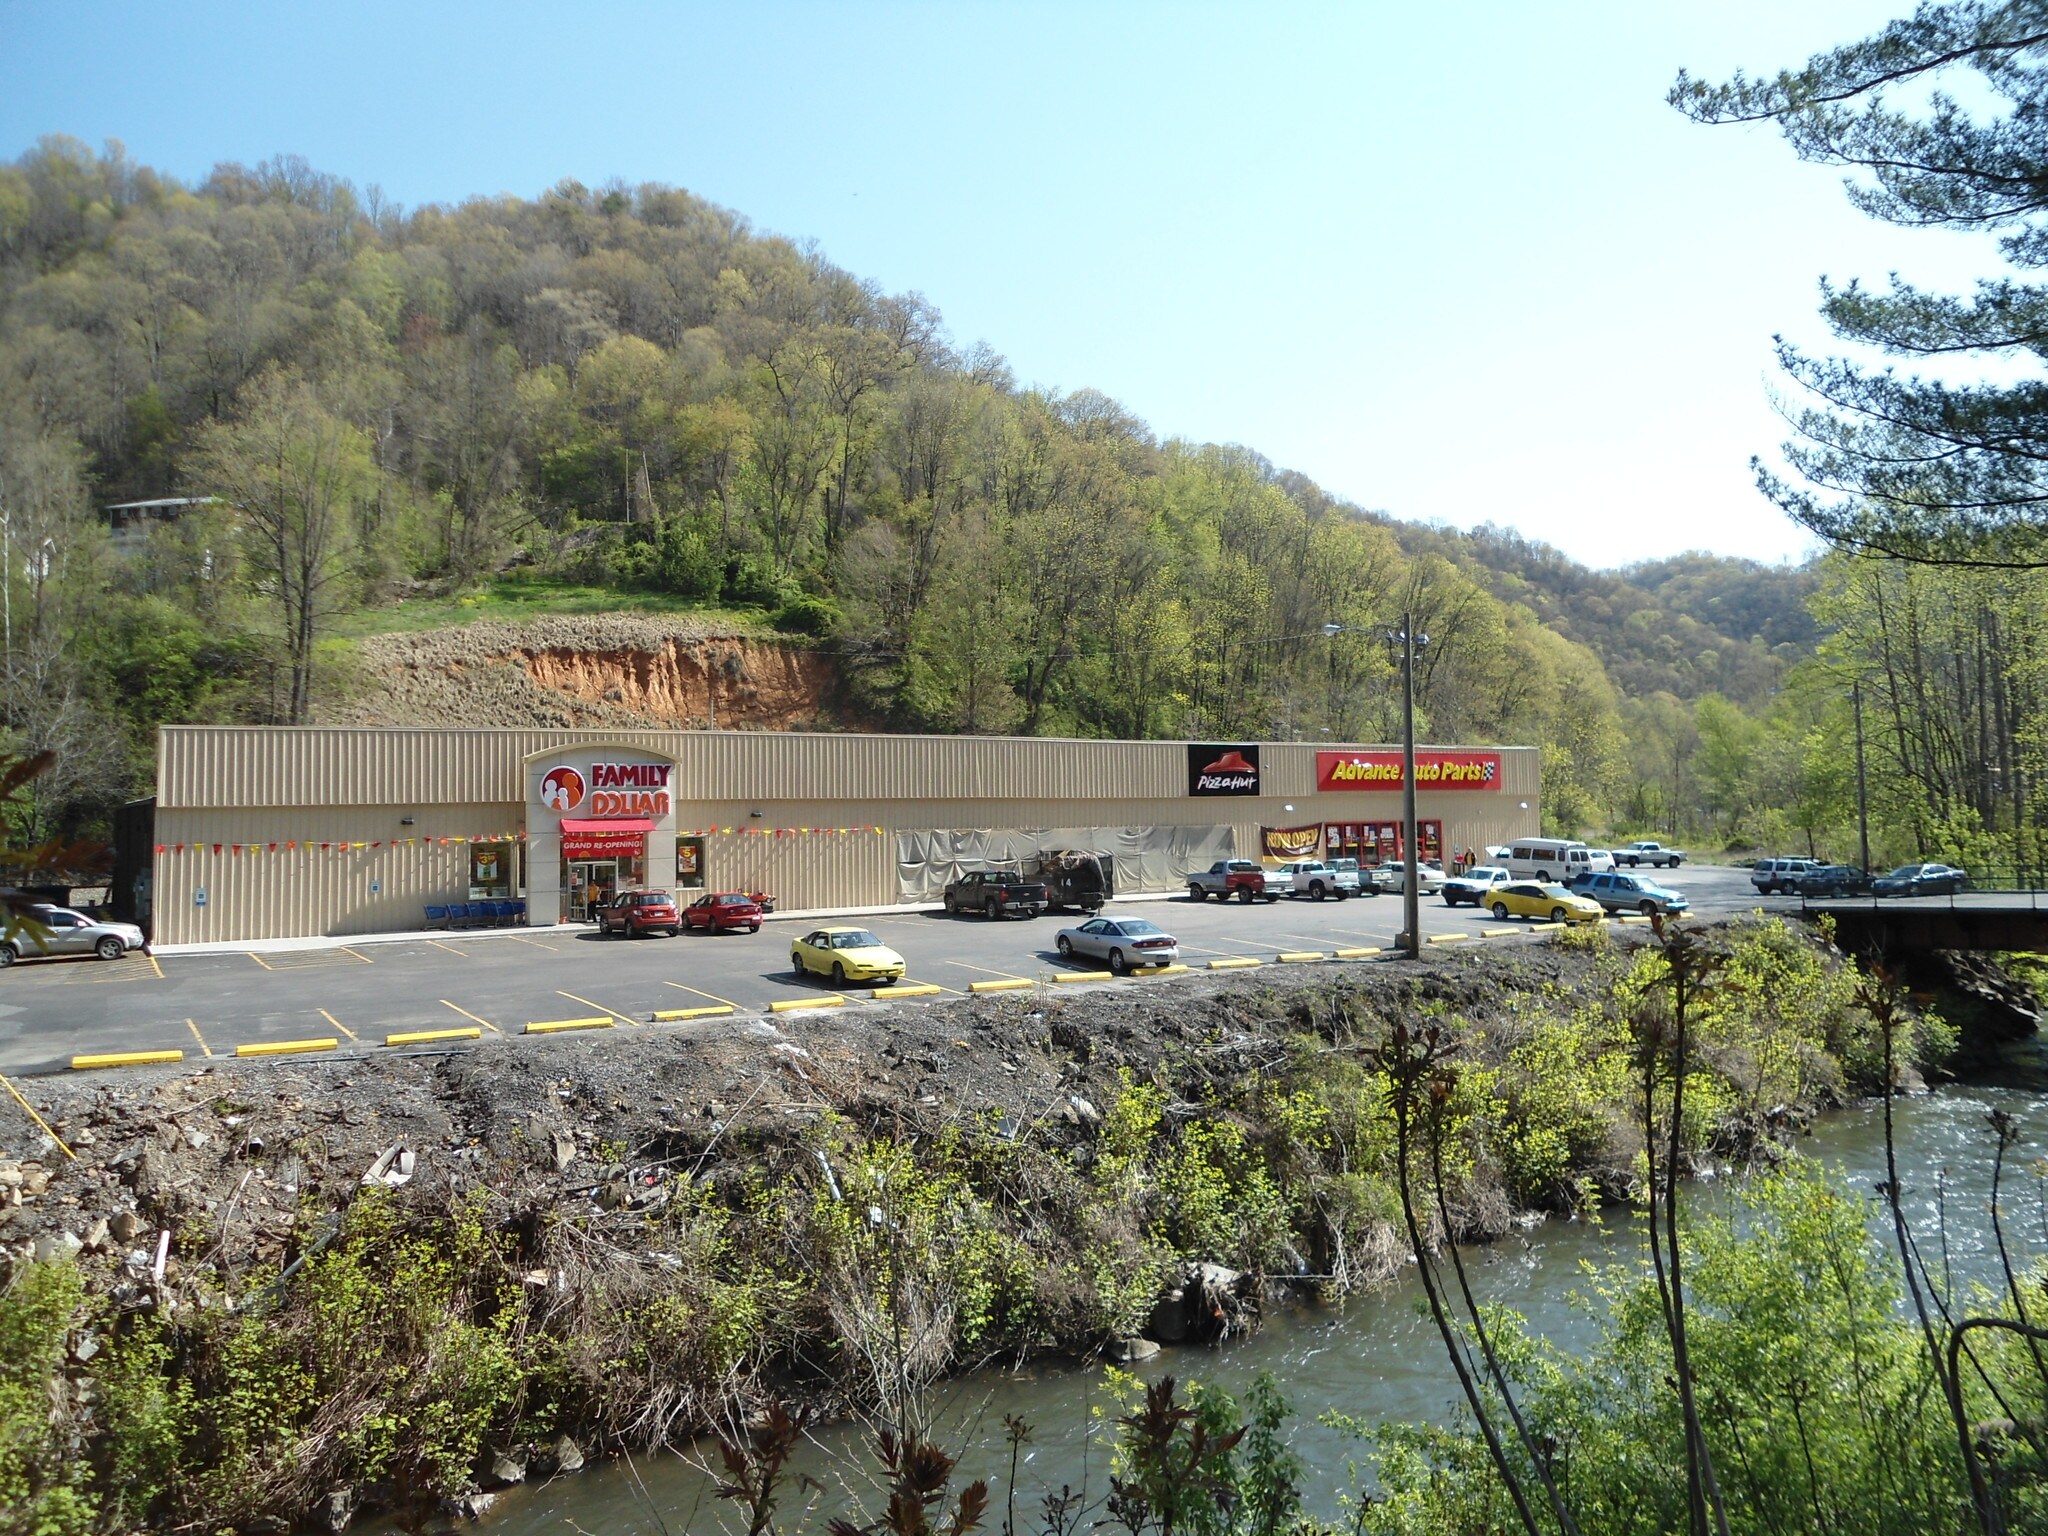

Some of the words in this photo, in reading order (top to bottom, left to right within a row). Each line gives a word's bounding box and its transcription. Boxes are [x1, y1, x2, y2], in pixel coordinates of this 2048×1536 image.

[591, 763, 672, 788] FAMILY
[1332, 760, 1400, 781] Advance
[1401, 761, 1440, 781] uto
[1441, 761, 1482, 781] Parts
[1197, 775, 1231, 790] Pizza
[1230, 776, 1257, 790] Hut
[591, 790, 671, 816] DOLLAR
[593, 841, 643, 849] RE-OPENING!
[1291, 828, 1318, 848] OPEN
